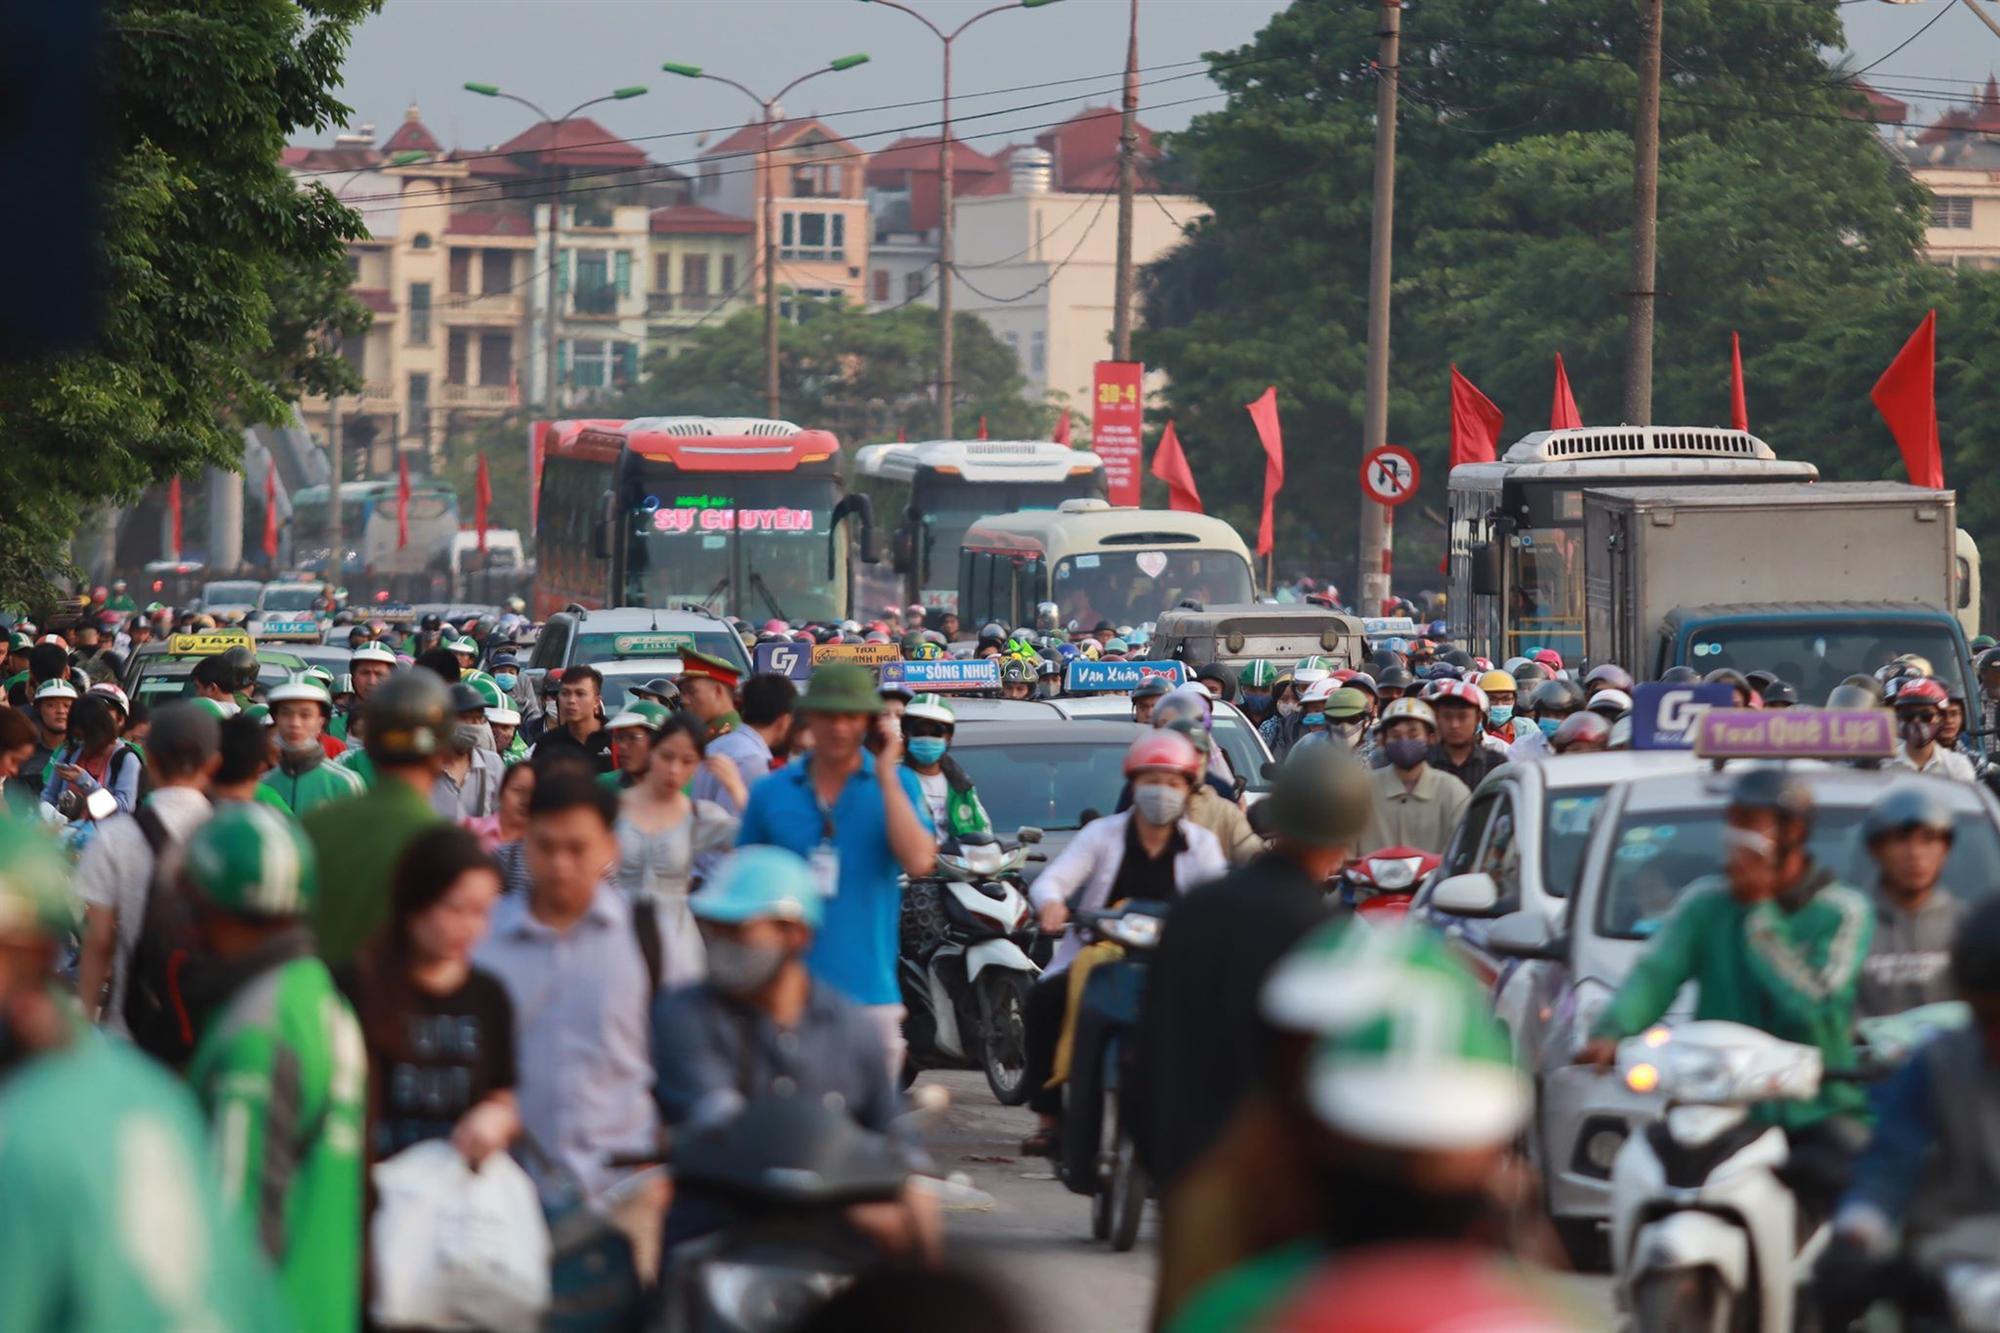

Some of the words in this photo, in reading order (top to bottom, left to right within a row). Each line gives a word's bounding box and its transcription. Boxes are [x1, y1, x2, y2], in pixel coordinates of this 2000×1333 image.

[654, 507, 698, 533] SỰ
[700, 506, 813, 530] CHUYÊN
[771, 647, 799, 676] G7
[907, 665, 925, 674] TAXI
[926, 662, 959, 680] SÔNG
[962, 661, 996, 683] NHUỆ
[1078, 667, 1104, 687] Vạn
[1107, 665, 1139, 682] Xuân
